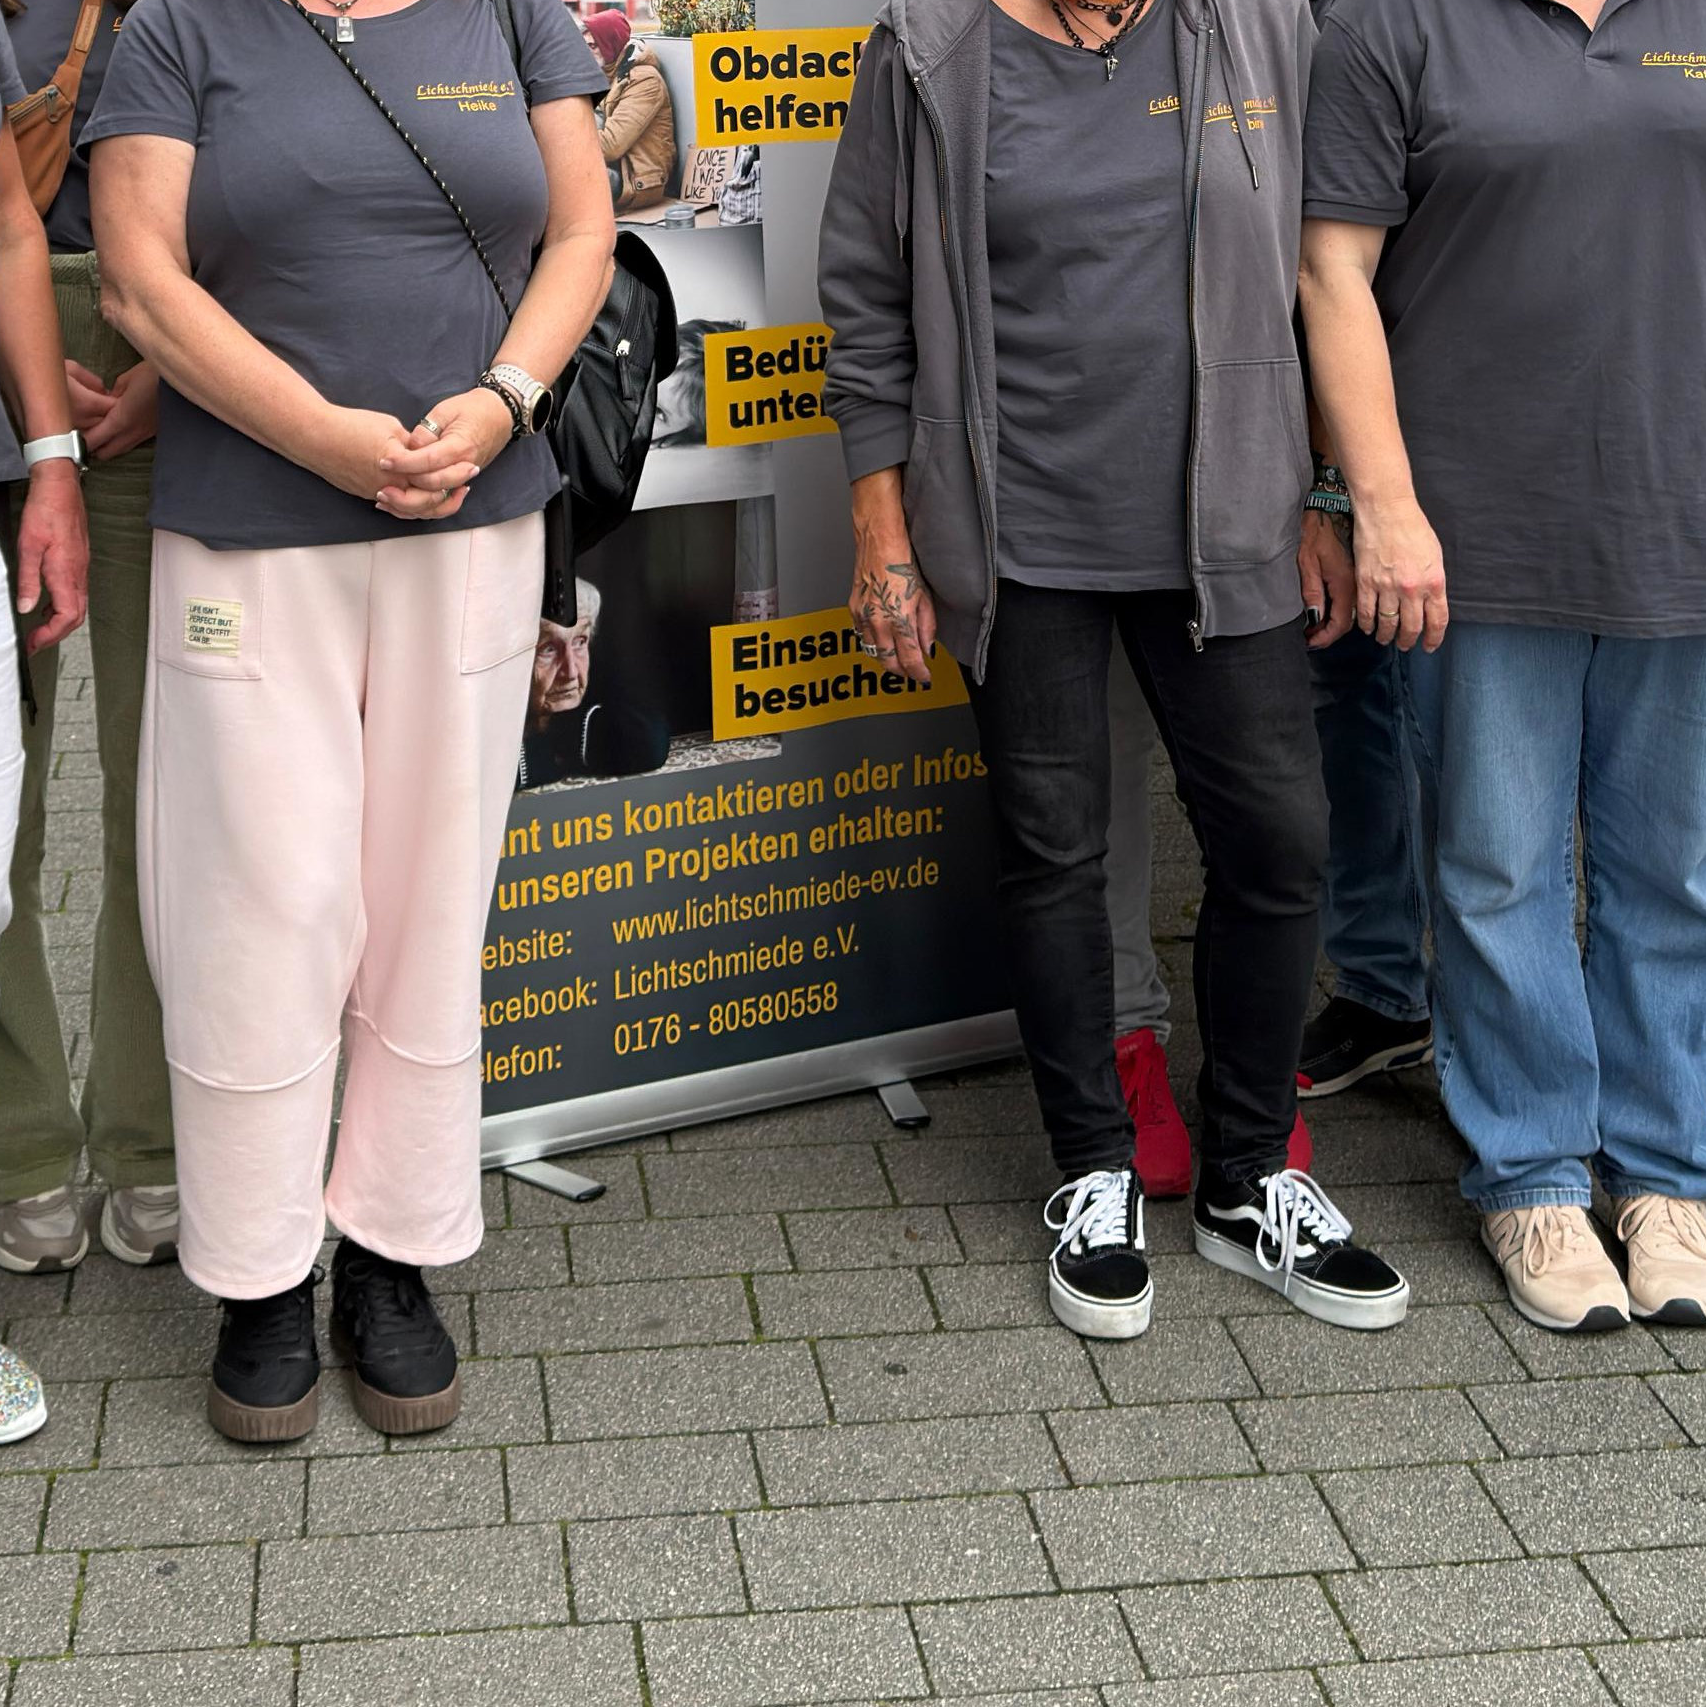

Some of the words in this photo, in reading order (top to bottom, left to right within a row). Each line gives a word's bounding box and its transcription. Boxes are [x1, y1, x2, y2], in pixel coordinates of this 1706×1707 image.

[416, 80, 499, 96] Lichtschmiede
[458, 99, 497, 112] Heike
[714, 93, 849, 134] helfen
[1149, 95, 1180, 111] Licht
[696, 149, 728, 166] ONCE
[684, 184, 706, 199] LIKE
[726, 335, 829, 383] Bedü
[189, 615, 216, 625] PERFECT
[218, 619, 233, 627] BUT
[189, 625, 205, 634] YOUR
[206, 628, 231, 637] OUTFIT
[500, 818, 541, 859] nt
[552, 812, 613, 849] uns
[624, 776, 825, 837] kontaktieren
[833, 757, 904, 799] oder
[913, 746, 989, 787] Infos
[497, 860, 634, 912] unseren
[645, 830, 799, 884] Projekten
[809, 804, 944, 854] erhalten:
[481, 928, 573, 971] ebsite:
[612, 856, 940, 944] www.lichtschmiede-ev.de
[480, 976, 598, 1029] acebook:
[613, 934, 804, 1001] Lichtschmiede
[813, 923, 860, 960] e.V.
[480, 1044, 563, 1084] lefon:
[613, 1012, 681, 1056] 0176
[708, 980, 839, 1036] 80580558
